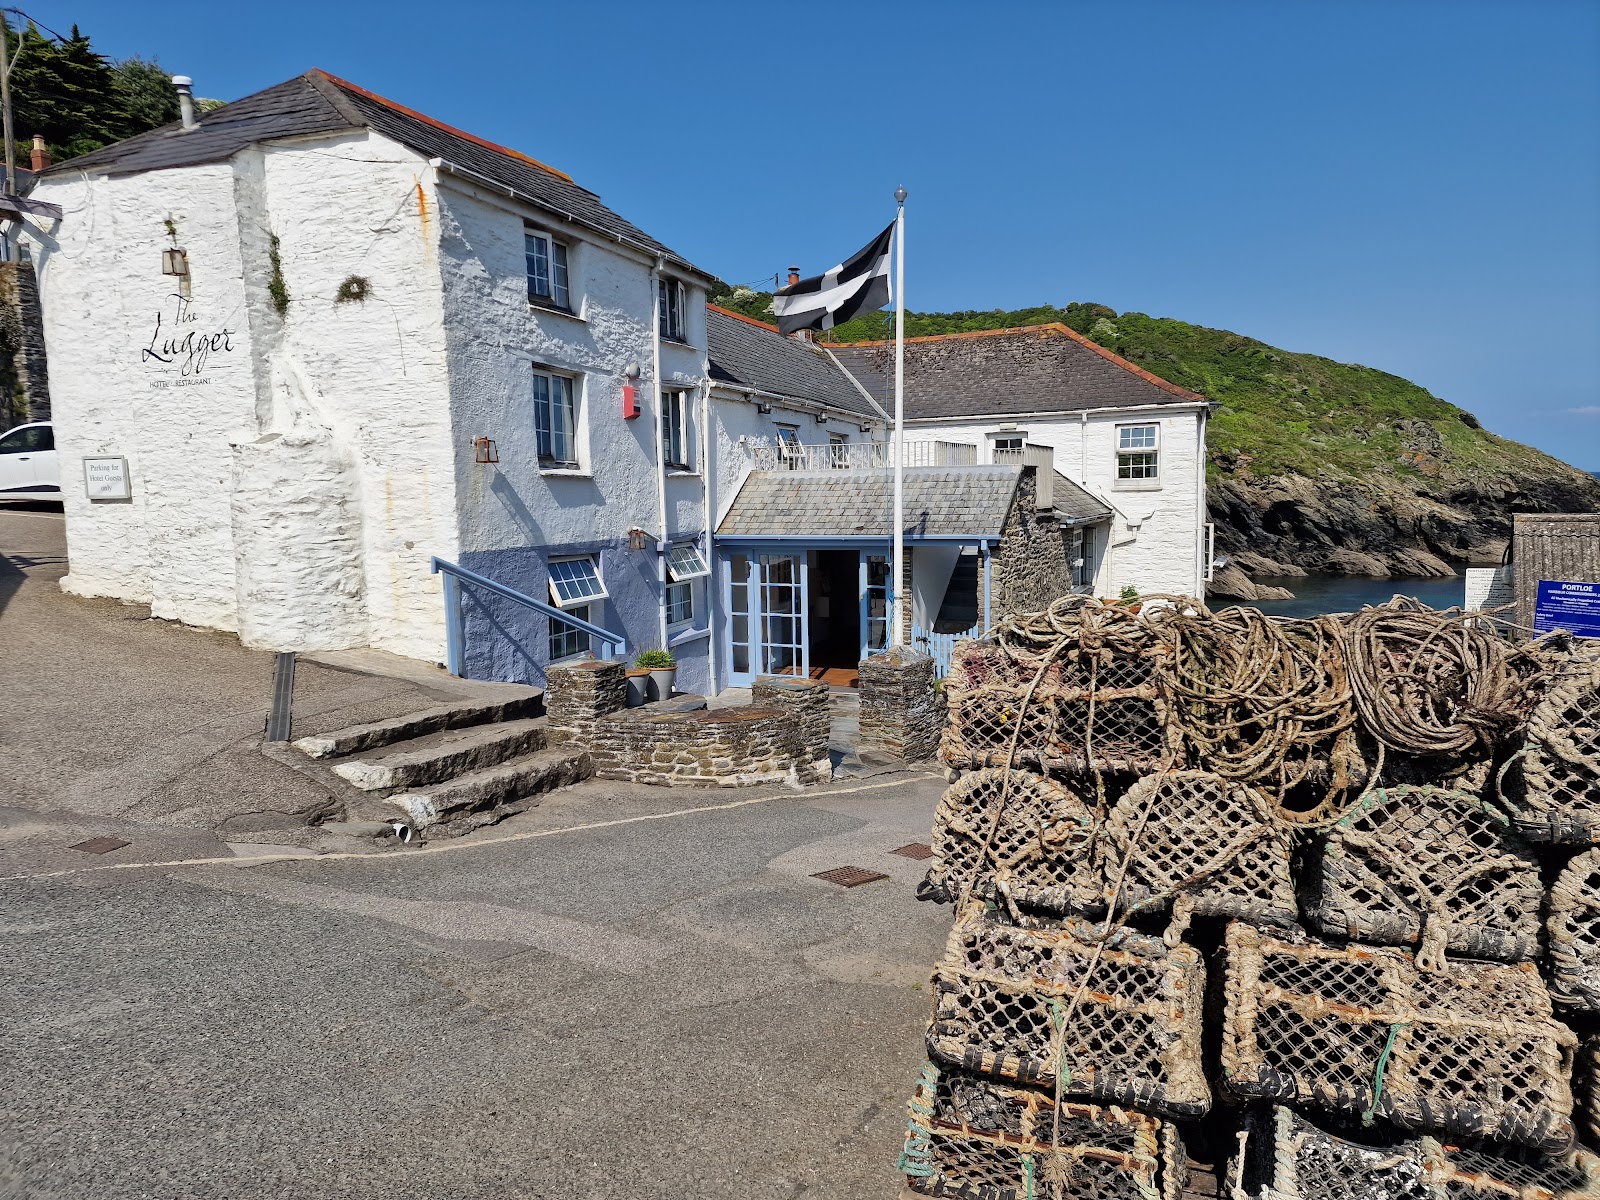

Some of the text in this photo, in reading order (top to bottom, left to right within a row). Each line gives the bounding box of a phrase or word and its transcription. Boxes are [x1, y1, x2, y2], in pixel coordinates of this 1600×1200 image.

[165, 293, 199, 326] The
[142, 311, 236, 377] Lugger
[149, 377, 211, 388] HOTEL RESTAURANT
[90, 464, 110, 472] Parking
[1562, 584, 1593, 592] PORTLOE
